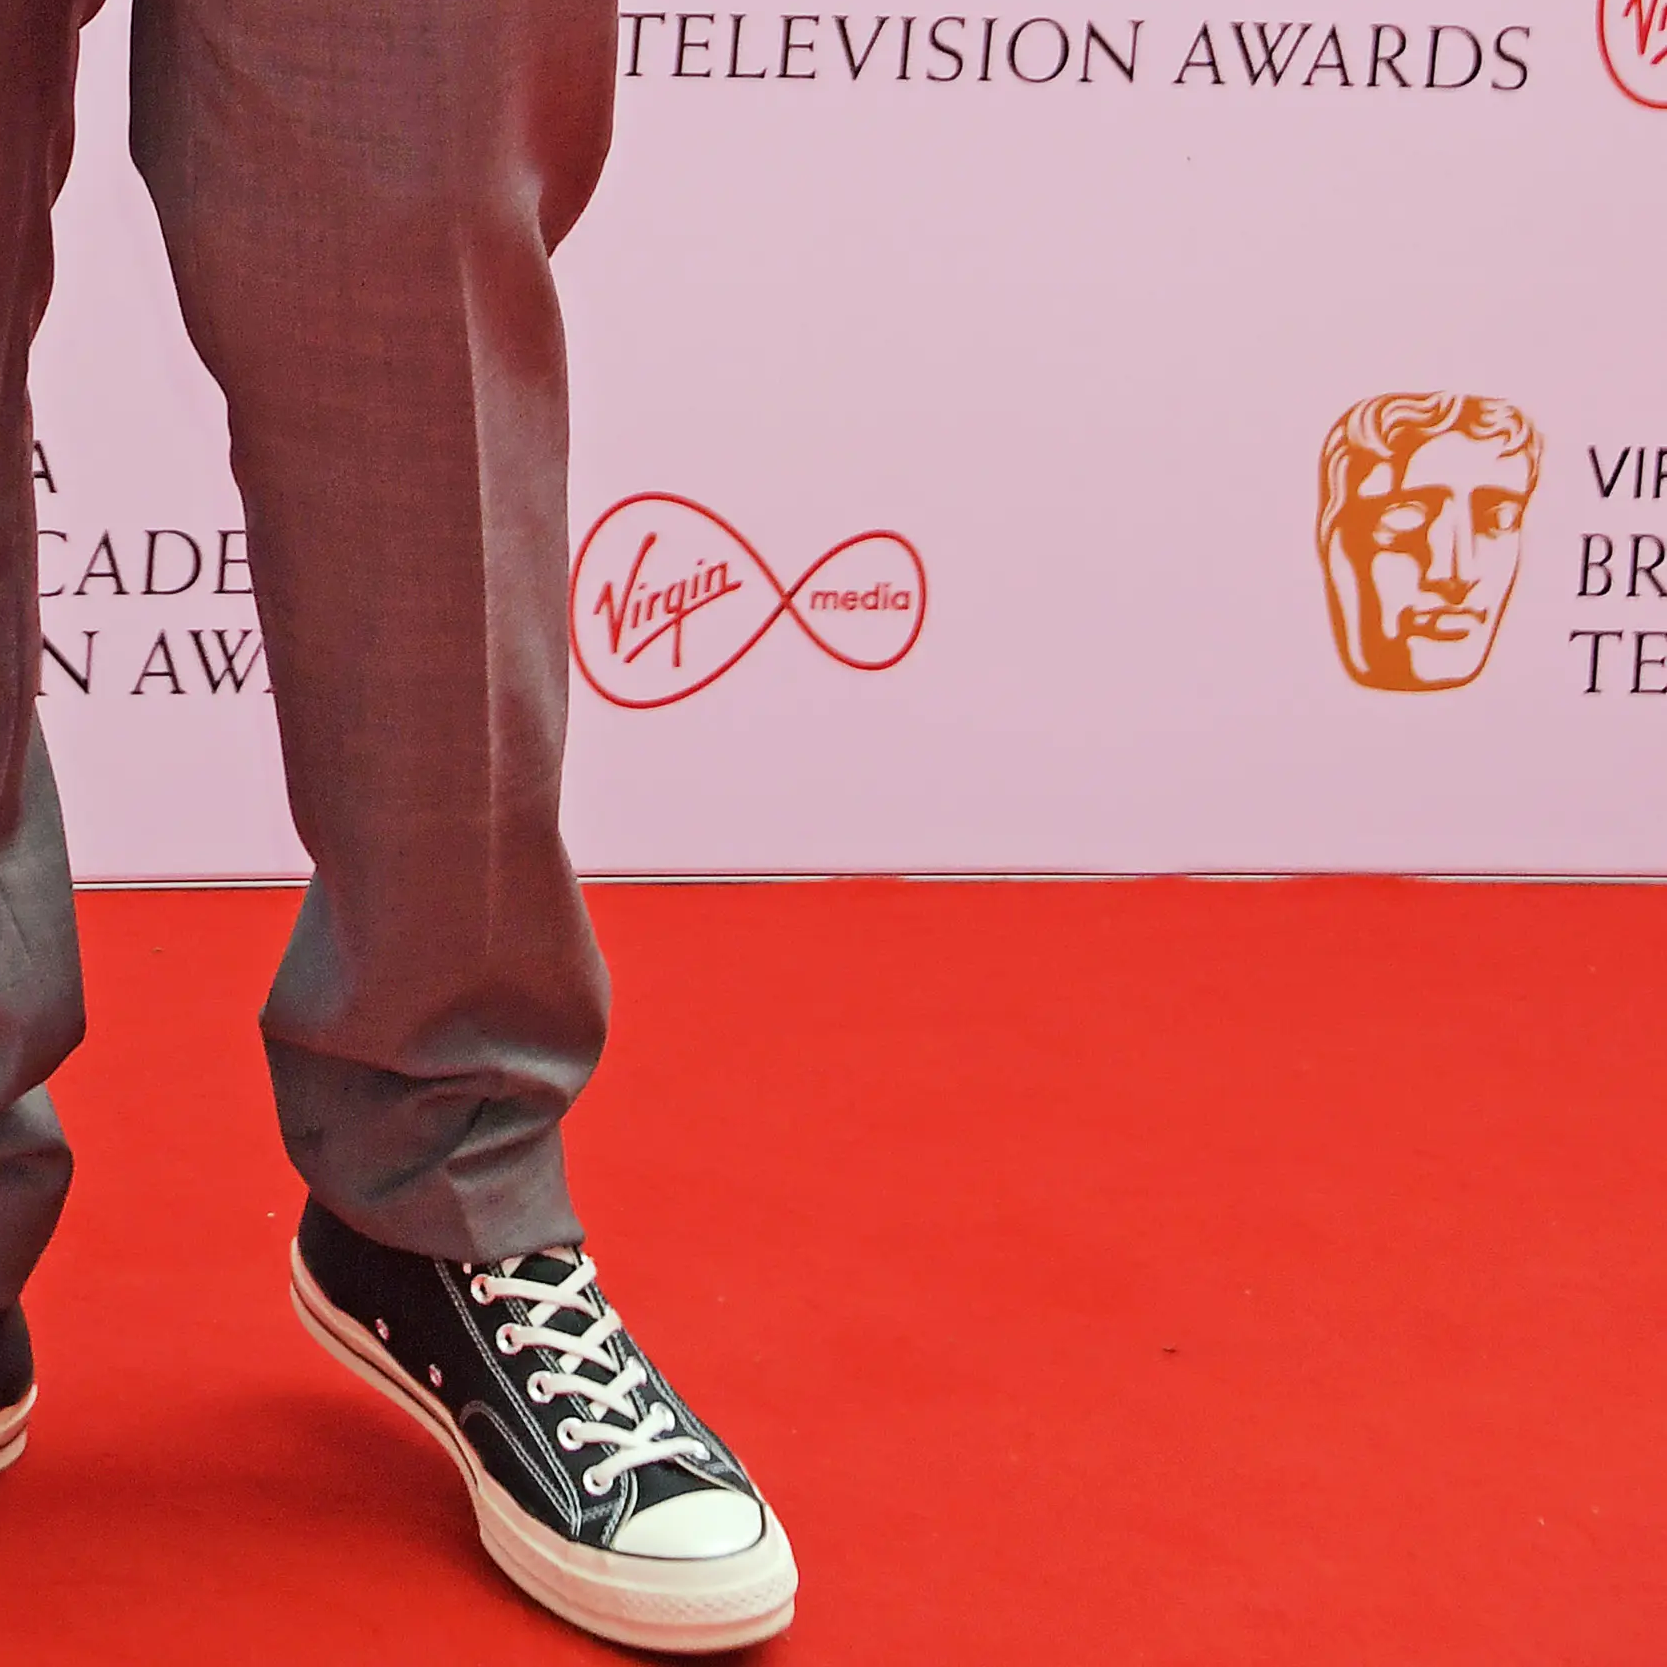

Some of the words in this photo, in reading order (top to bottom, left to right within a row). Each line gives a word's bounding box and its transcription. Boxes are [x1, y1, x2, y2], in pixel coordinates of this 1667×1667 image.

[620, 12, 1144, 83] TELEVISION
[1173, 22, 1530, 91] AWARDS
[593, 532, 742, 667] Virgin
[810, 583, 910, 611] media
